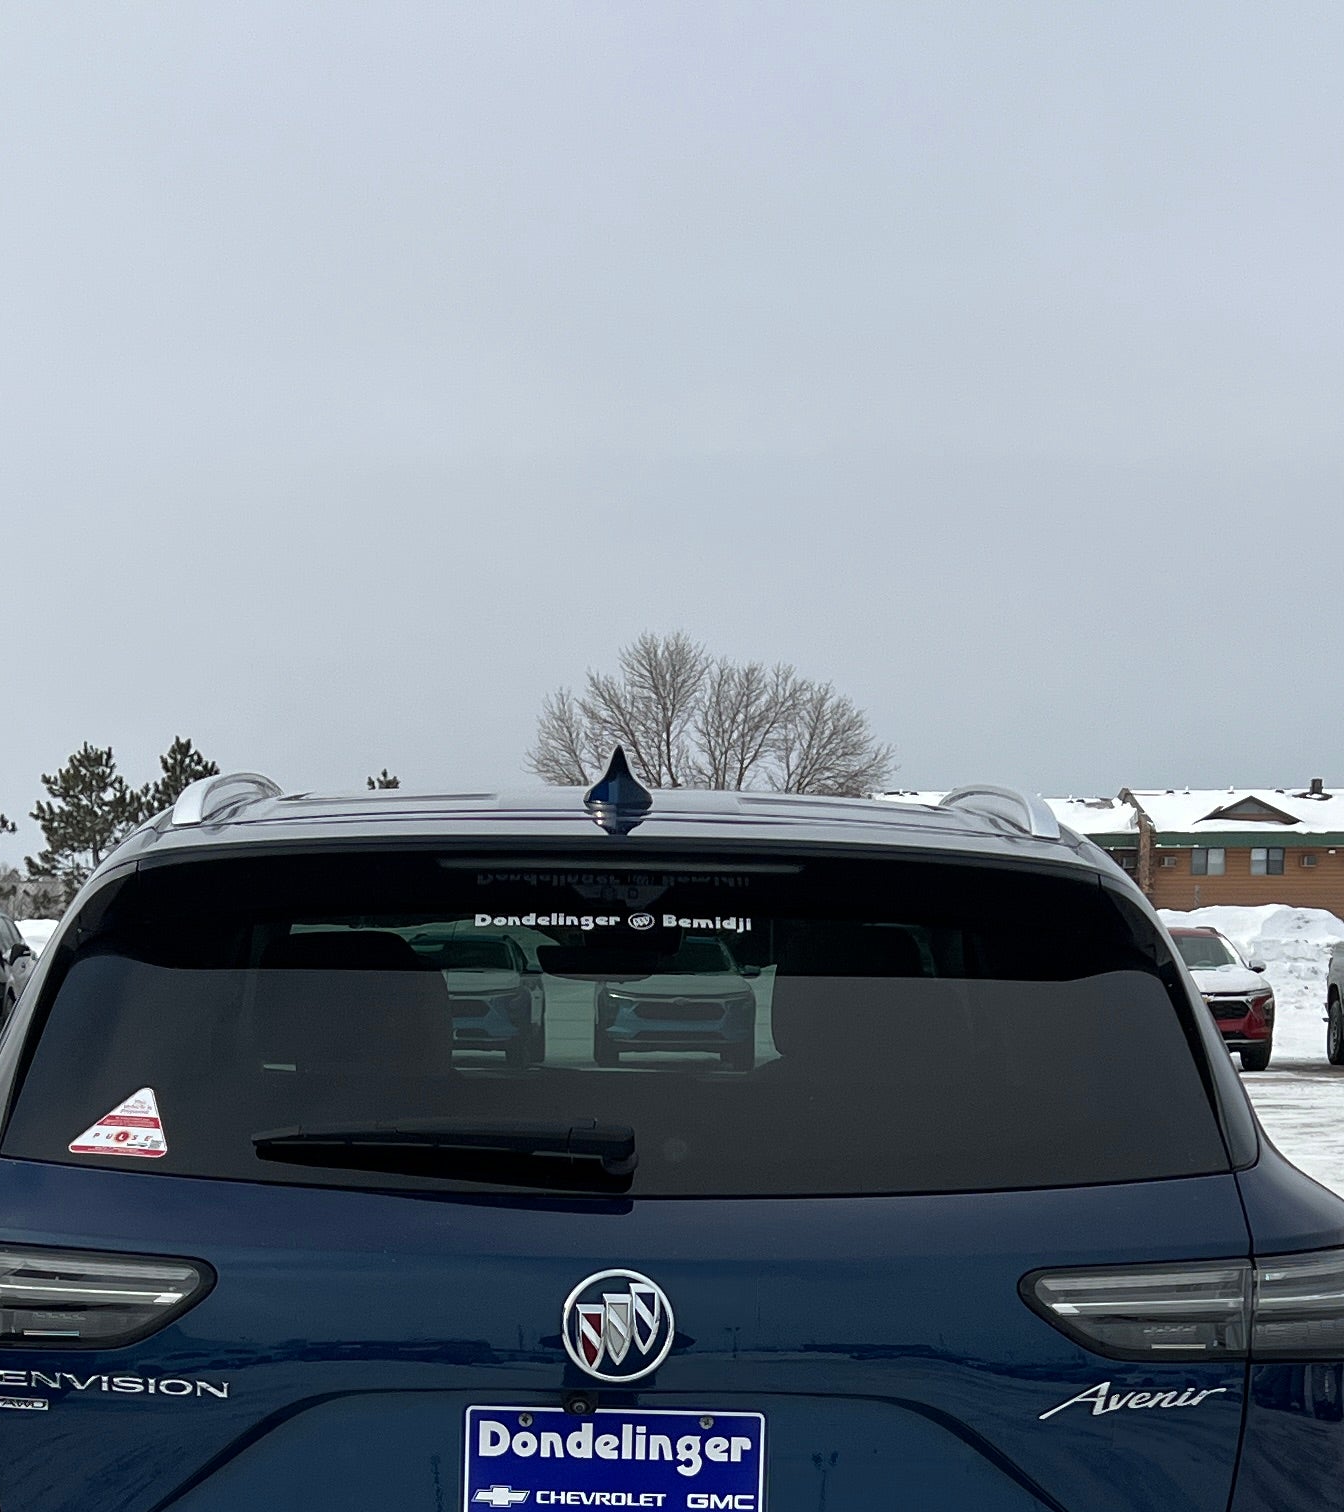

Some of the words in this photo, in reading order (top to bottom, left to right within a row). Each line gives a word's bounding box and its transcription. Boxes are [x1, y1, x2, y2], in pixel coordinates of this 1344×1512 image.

[474, 912, 621, 930] Dondelinger
[662, 914, 752, 933] Bemidji
[92, 1132, 154, 1142] PULSE
[0, 1397, 49, 1410] AWD
[1038, 1381, 1228, 1420] Avenir
[477, 1420, 752, 1478] Dondelinger
[536, 1490, 667, 1507] CHEVROLET
[686, 1493, 755, 1510] GMC
